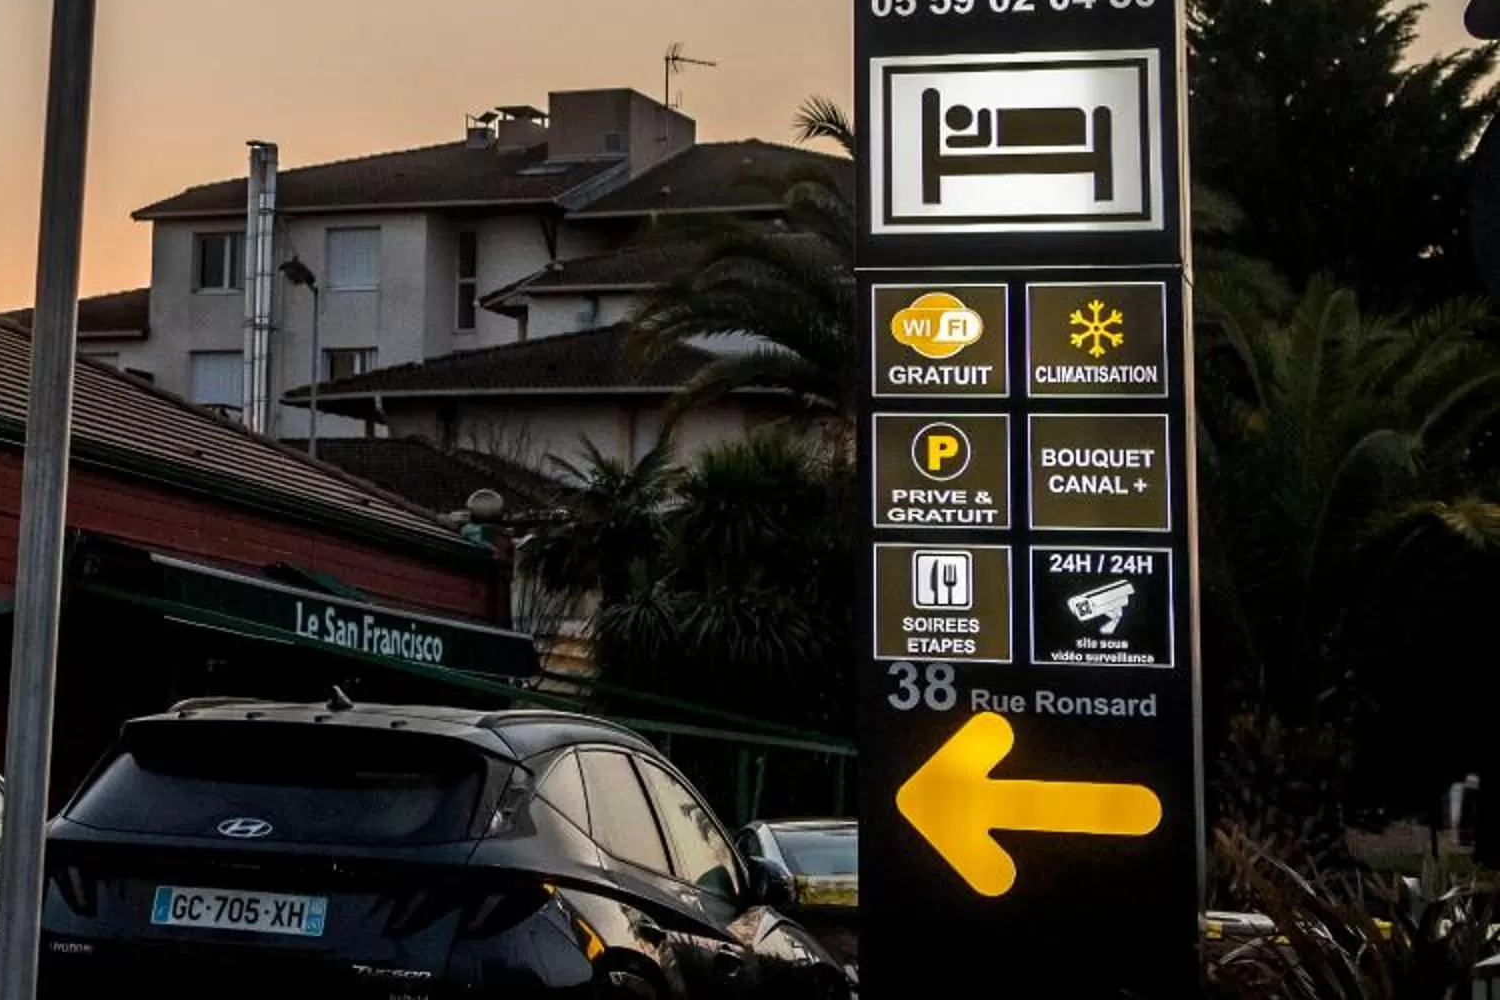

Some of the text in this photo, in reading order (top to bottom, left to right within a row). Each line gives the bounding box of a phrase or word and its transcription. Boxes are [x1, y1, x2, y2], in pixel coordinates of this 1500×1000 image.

[888, 365, 992, 385] GRATUIT
[1035, 365, 1158, 384] CLIMATISATION
[927, 435, 959, 471] P
[1041, 449, 1155, 470] BOUQUET
[1048, 474, 1128, 495] CANAL
[892, 489, 993, 505] PRIVE &
[887, 508, 998, 525] GRATUIT
[1049, 553, 1091, 573] 24H
[1110, 555, 1153, 574] 24H
[296, 601, 443, 663] Le San Francisco
[902, 616, 980, 634] SOIREES
[907, 637, 976, 655] ETAPES
[1076, 637, 1129, 649] site sous
[1051, 650, 1155, 664] vidéo surveillance
[886, 662, 1157, 717] 38 Rue Ronsard
